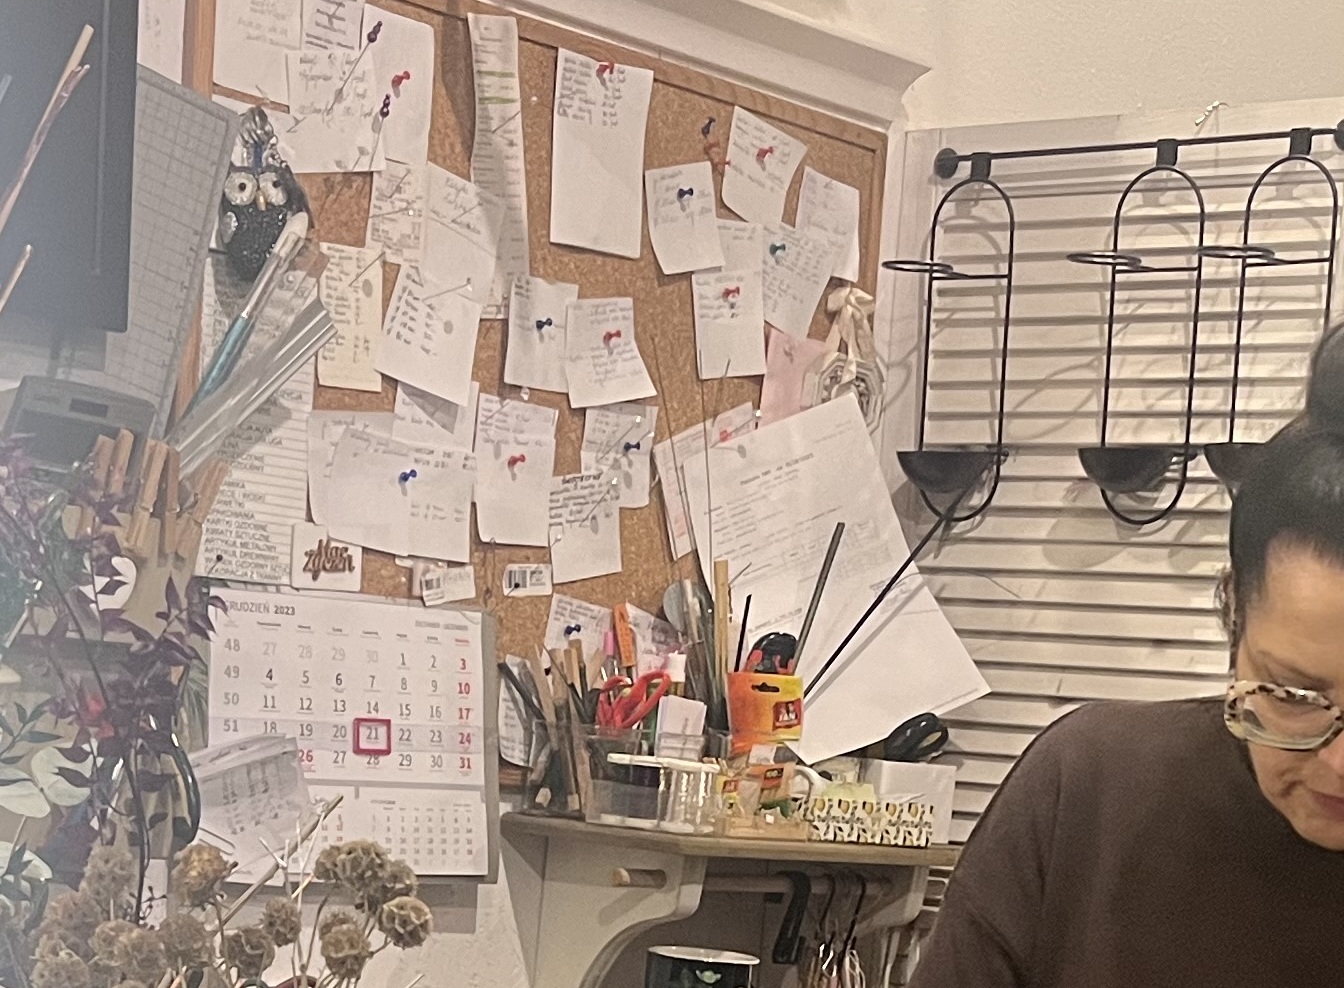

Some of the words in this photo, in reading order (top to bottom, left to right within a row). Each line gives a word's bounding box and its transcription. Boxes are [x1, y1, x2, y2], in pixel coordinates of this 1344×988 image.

[227, 600, 271, 614] RUDZIEŃ
[274, 604, 296, 616] 2023
[224, 638, 241, 652] 48
[262, 642, 277, 656] 27
[400, 652, 407, 666] 1
[430, 654, 437, 669] 2
[460, 657, 467, 671] 3
[265, 668, 273, 681] 4
[302, 670, 310, 684] 5
[335, 672, 343, 686] 6
[369, 674, 376, 688] 7
[400, 677, 408, 691] 8
[431, 679, 438, 693] 9
[458, 682, 471, 695] 10
[223, 692, 240, 706] 50
[263, 695, 276, 709] 11
[299, 697, 312, 711] 12
[333, 699, 346, 713] 13
[367, 701, 379, 714] 14
[399, 703, 411, 717] 15
[430, 705, 442, 719] 16
[459, 707, 471, 720] 17
[223, 719, 239, 733] 51
[263, 721, 277, 735] 18
[299, 723, 313, 737] 19
[332, 725, 347, 739] 20
[367, 726, 379, 740] 21
[399, 728, 412, 742] 22
[430, 730, 442, 744] 23
[459, 732, 471, 745] 24
[299, 749, 313, 763] 26
[332, 750, 346, 764] 27
[367, 755, 380, 766] 28
[399, 753, 412, 767] 29
[431, 755, 443, 769] 30
[460, 757, 472, 770] 31
